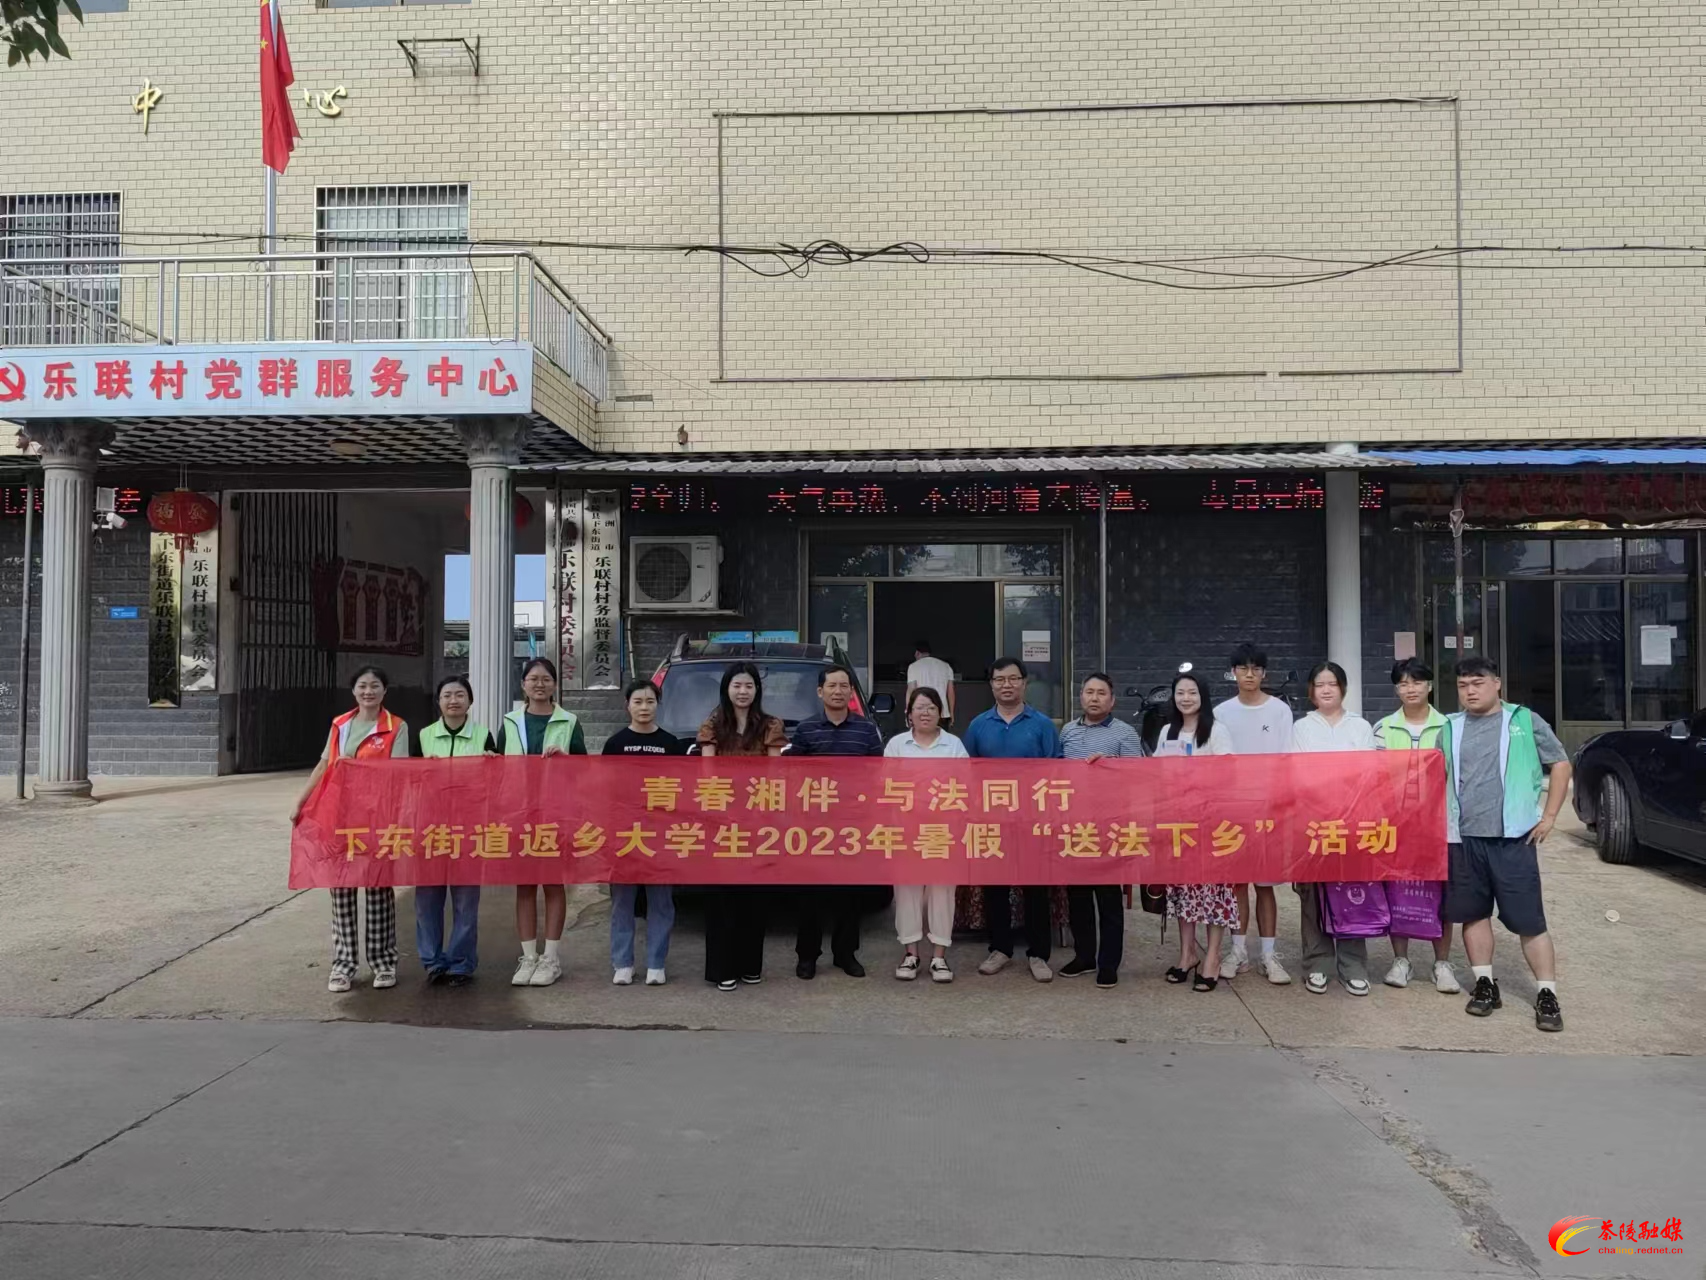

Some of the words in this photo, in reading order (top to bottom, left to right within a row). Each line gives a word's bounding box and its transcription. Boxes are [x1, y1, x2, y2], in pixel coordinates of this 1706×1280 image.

[43, 356, 519, 401] 乐联村党群服务中心
[641, 776, 1075, 813] 青春湘伴·与法同行
